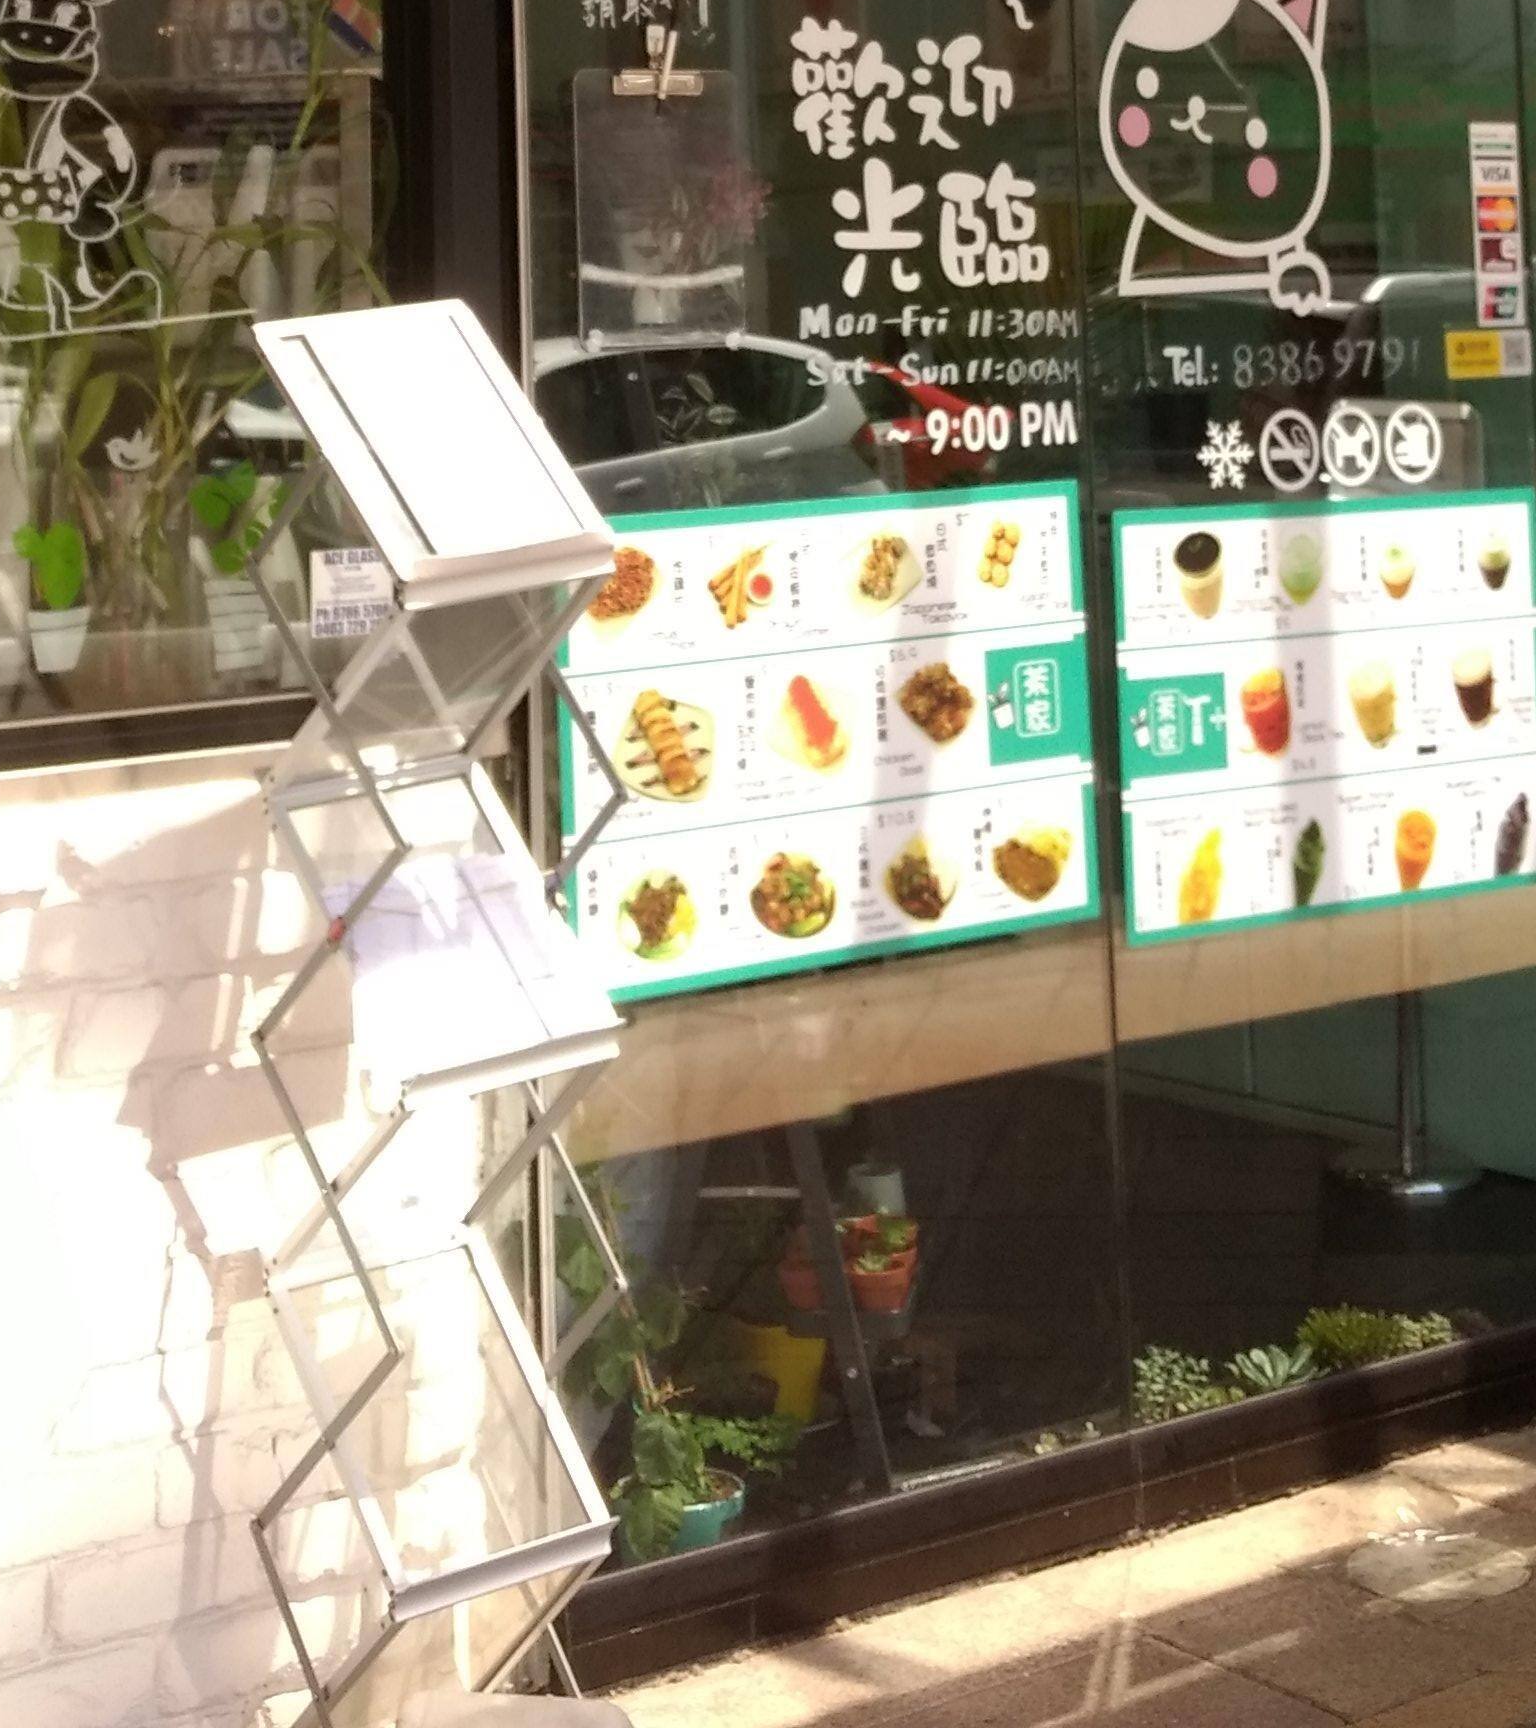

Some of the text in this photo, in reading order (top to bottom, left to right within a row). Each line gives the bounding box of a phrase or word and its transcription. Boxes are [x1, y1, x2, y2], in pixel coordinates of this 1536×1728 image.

[791, 16, 1014, 160] 歡迎
[1480, 166, 1512, 182] VISA
[831, 157, 1050, 298] 光臨
[925, 406, 1010, 455] 9:00
[1019, 400, 1079, 448] PM
